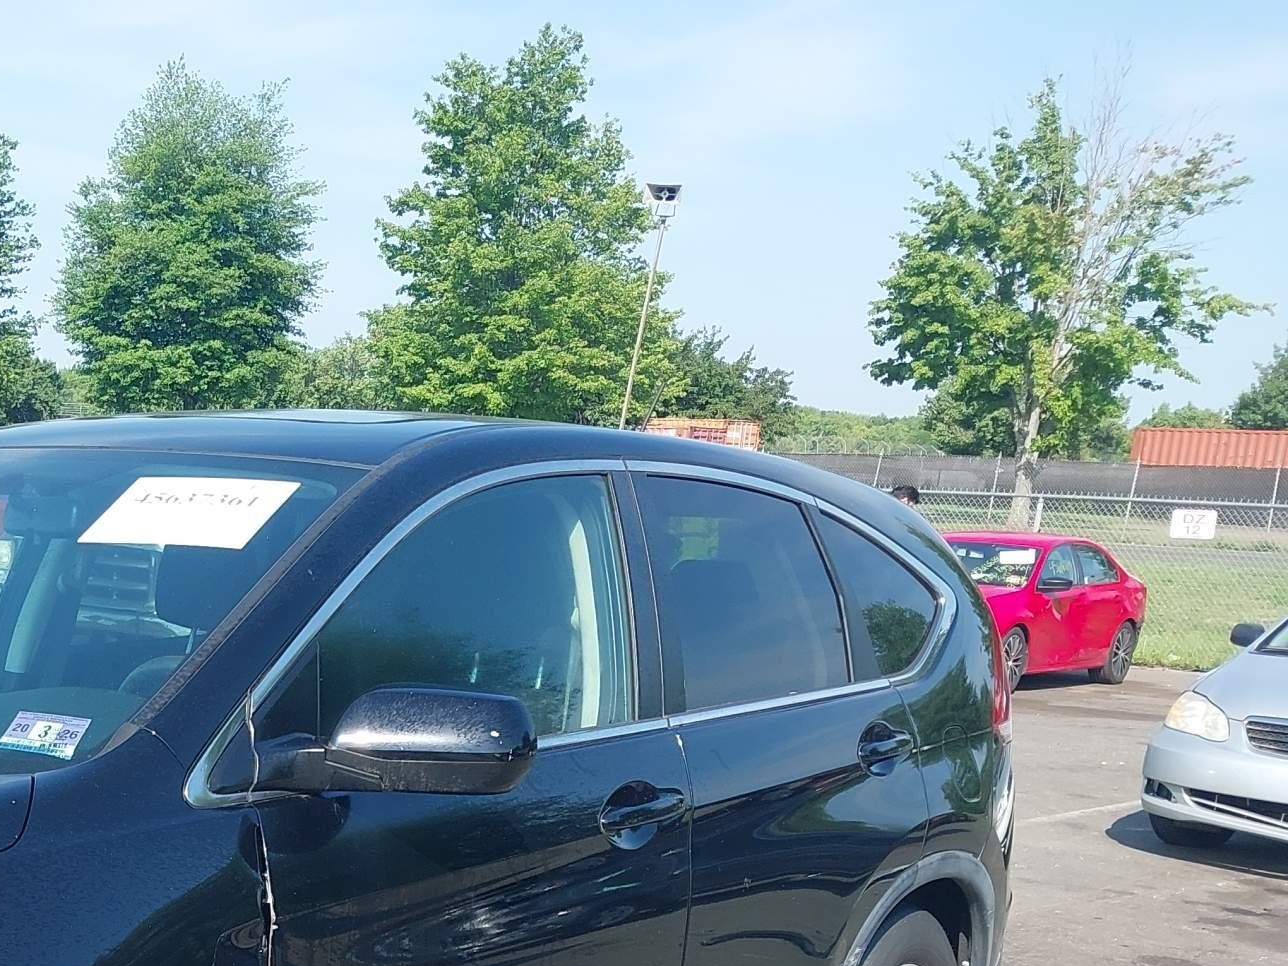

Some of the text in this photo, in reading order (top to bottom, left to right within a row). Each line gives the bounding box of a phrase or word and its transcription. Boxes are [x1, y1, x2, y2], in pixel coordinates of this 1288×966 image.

[1185, 525, 1201, 535] 12
[11, 723, 81, 740] 20 3 26
